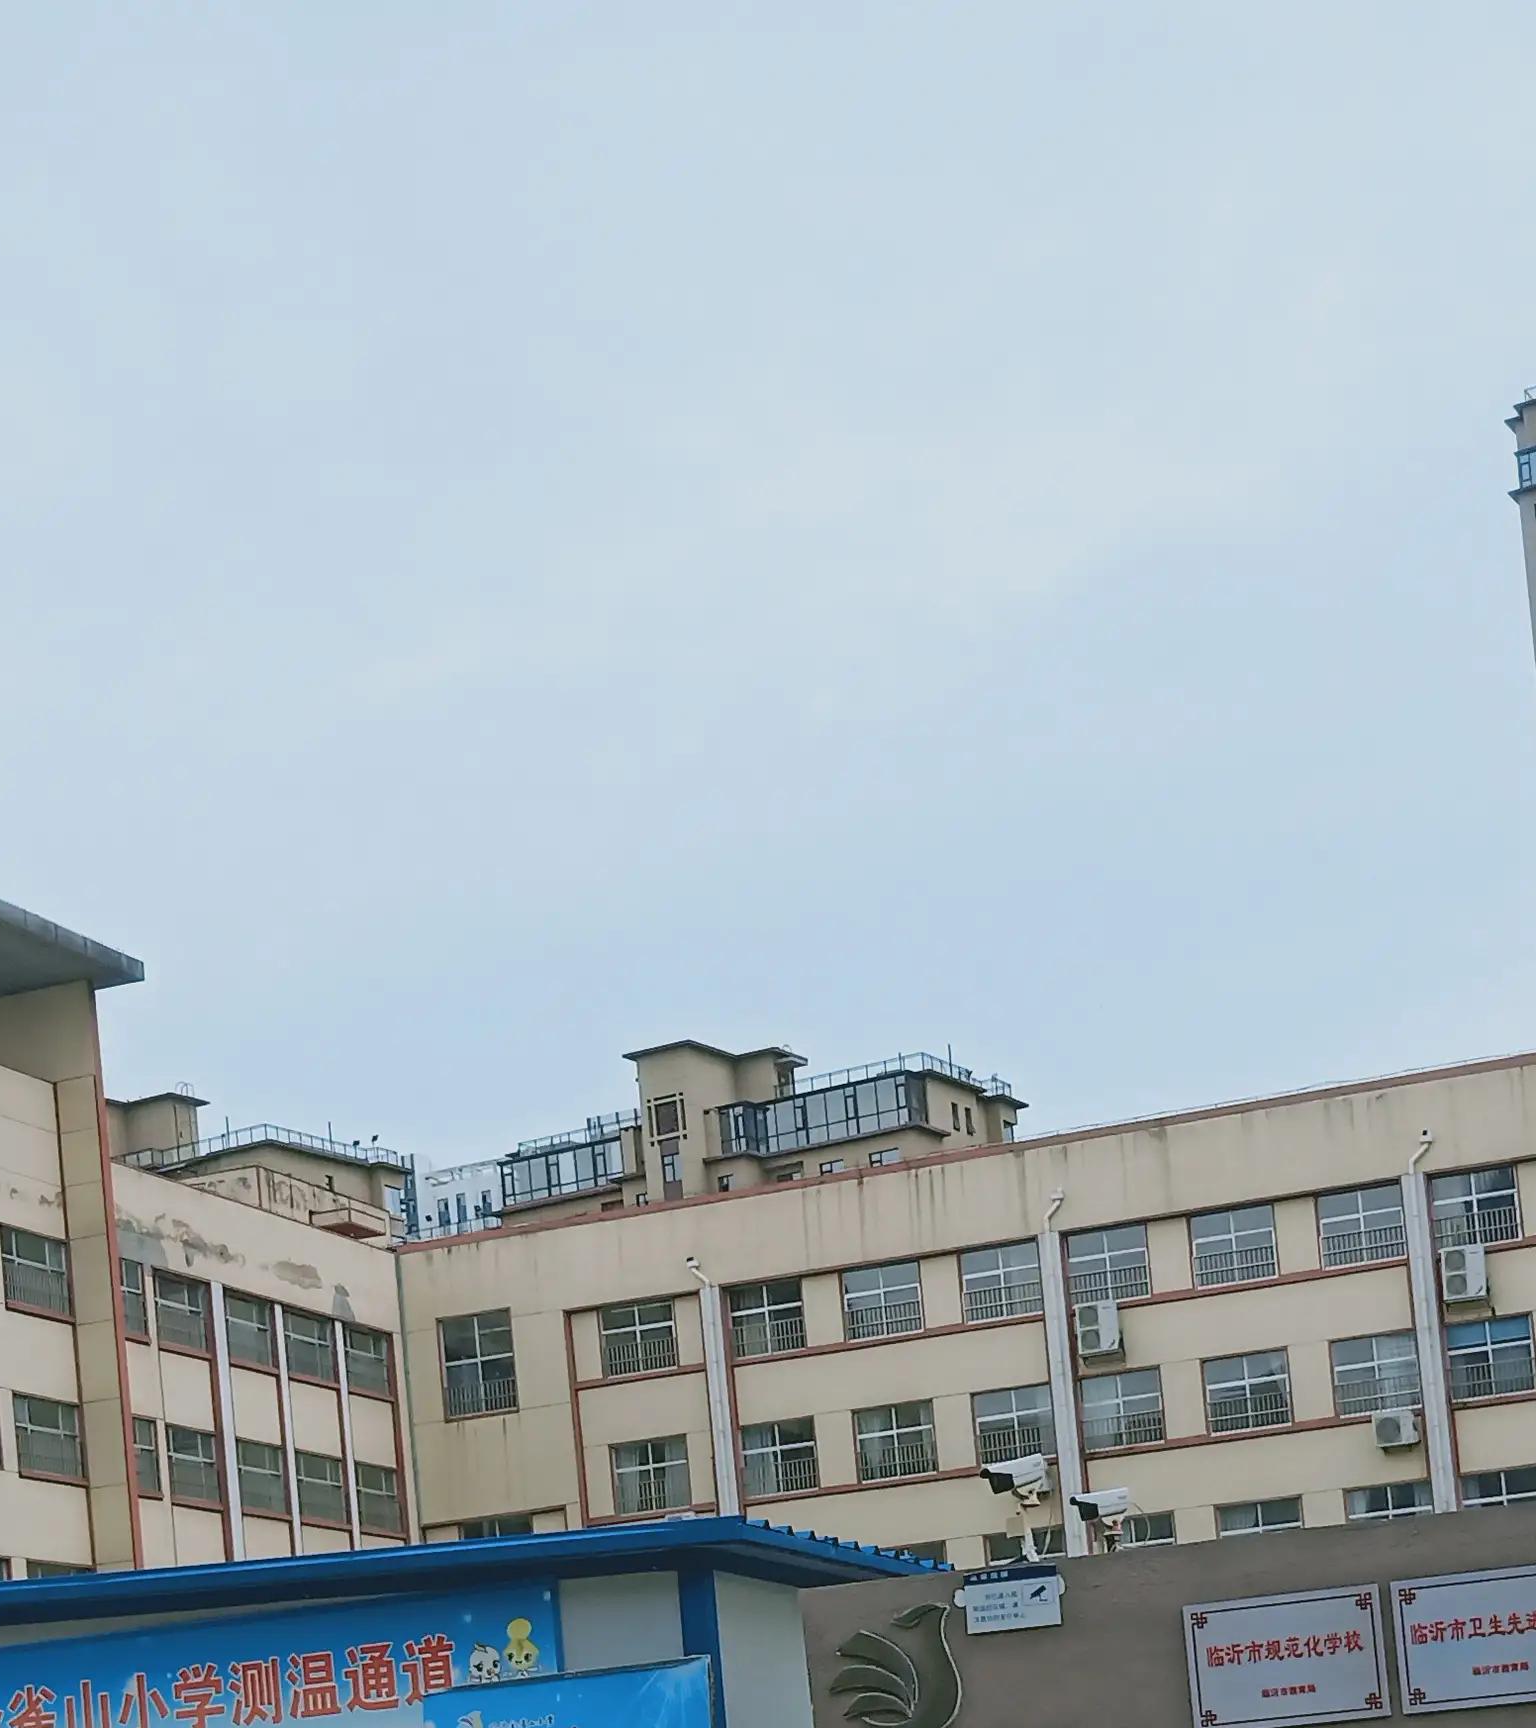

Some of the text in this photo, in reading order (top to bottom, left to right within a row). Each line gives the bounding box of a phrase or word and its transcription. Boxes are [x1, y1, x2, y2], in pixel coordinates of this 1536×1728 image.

[1205, 1629, 1365, 1669] 临沂市规范化学校
